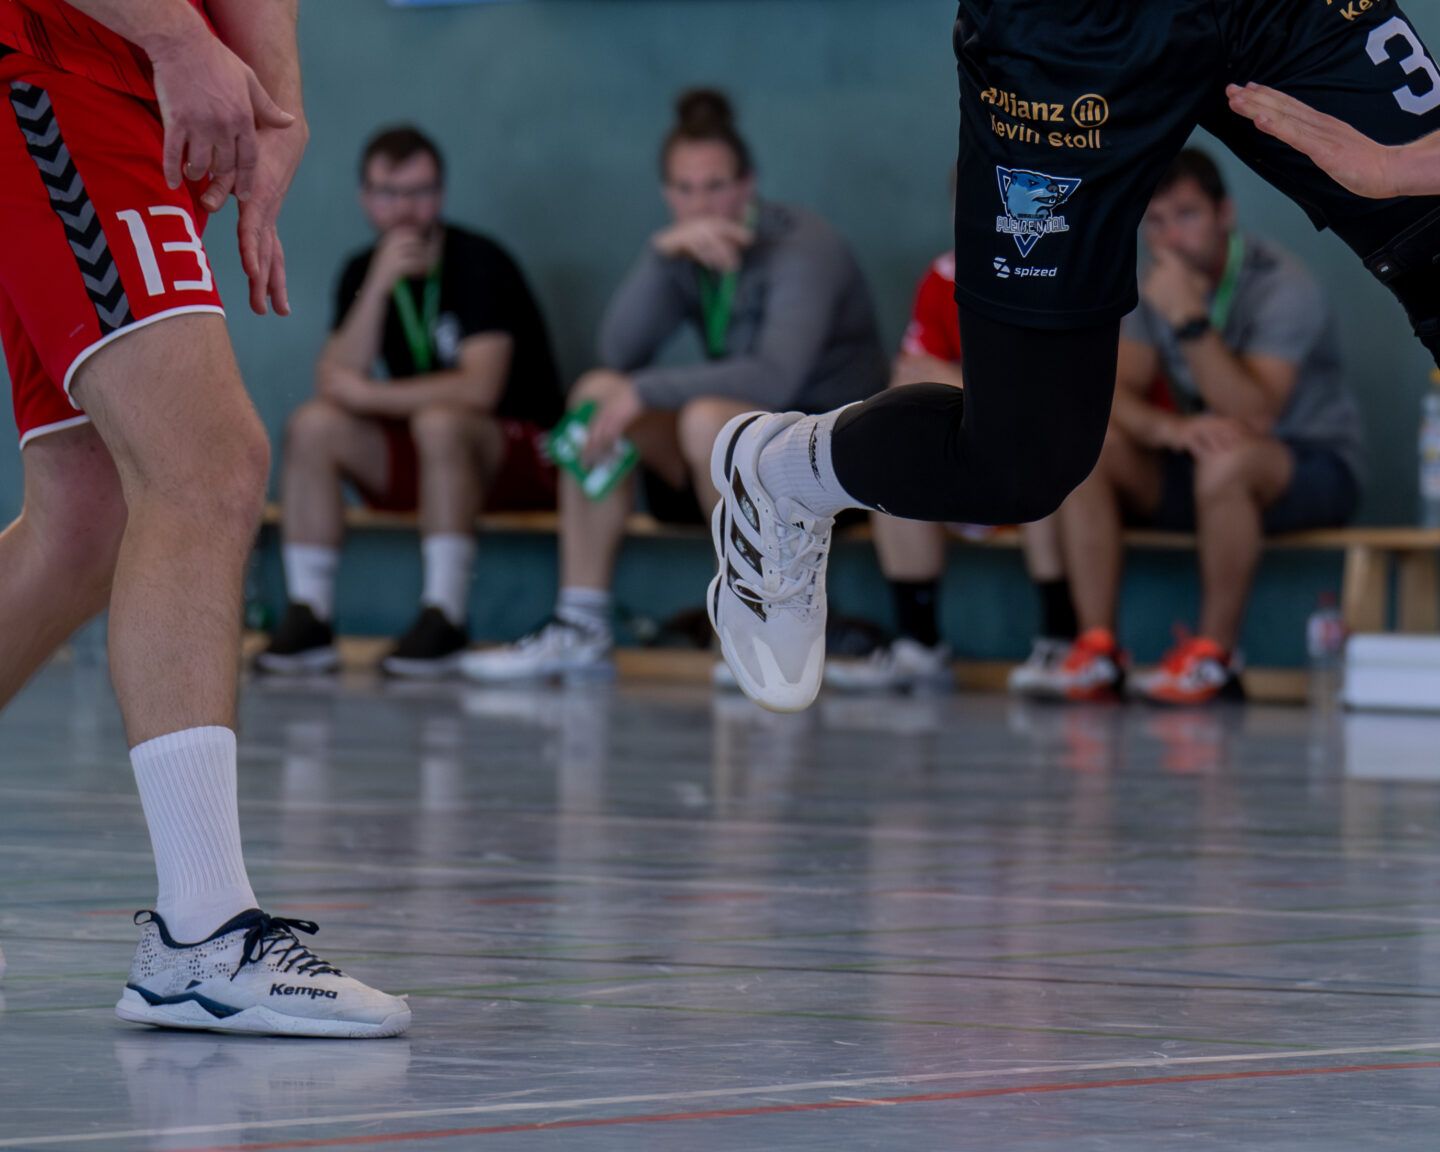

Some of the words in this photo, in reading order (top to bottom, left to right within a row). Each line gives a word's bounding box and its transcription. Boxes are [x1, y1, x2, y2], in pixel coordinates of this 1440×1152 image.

[981, 87, 1065, 122] Allianz
[990, 112, 1040, 145] Kevin
[1048, 129, 1101, 149] Stoll
[116, 205, 213, 297] 13
[1014, 266, 1058, 278] spized
[269, 982, 339, 1000] Kempa
